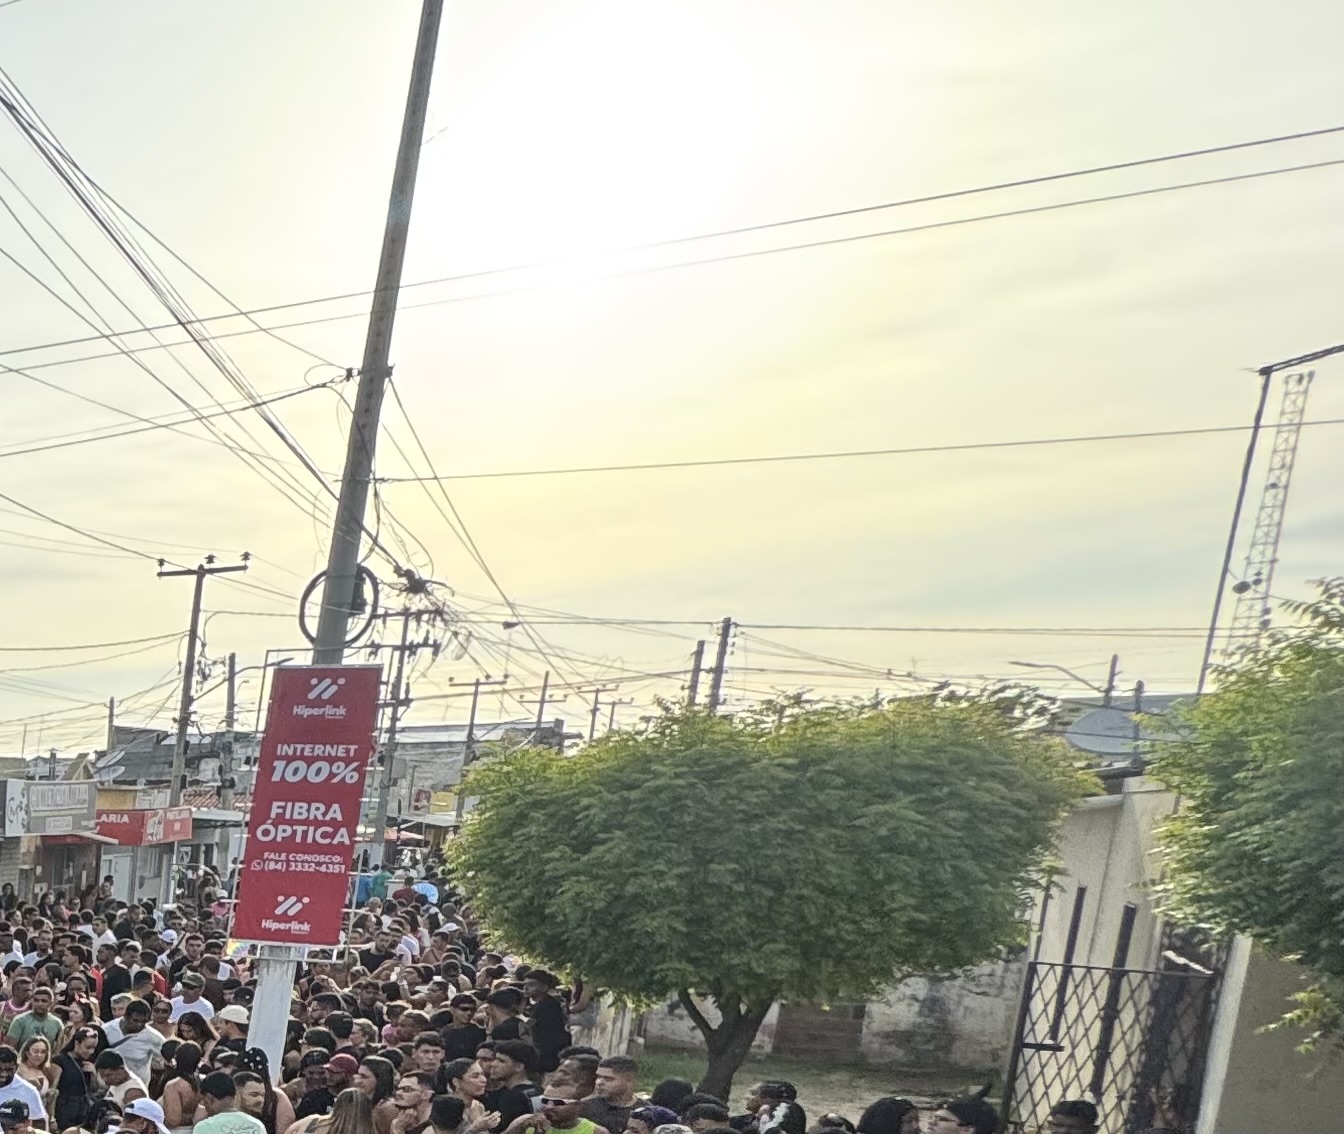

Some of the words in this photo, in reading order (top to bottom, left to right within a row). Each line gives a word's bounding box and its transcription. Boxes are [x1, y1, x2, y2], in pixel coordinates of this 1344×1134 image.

[293, 704, 347, 719] Hiperlink
[276, 743, 359, 757] INTERNET
[270, 759, 360, 784] 100%
[270, 801, 343, 821] FIBRA
[255, 819, 351, 845] ÓPTICA
[263, 851, 288, 861] FALE
[264, 860, 287, 873] (84)
[261, 919, 312, 935] Hiperlink
